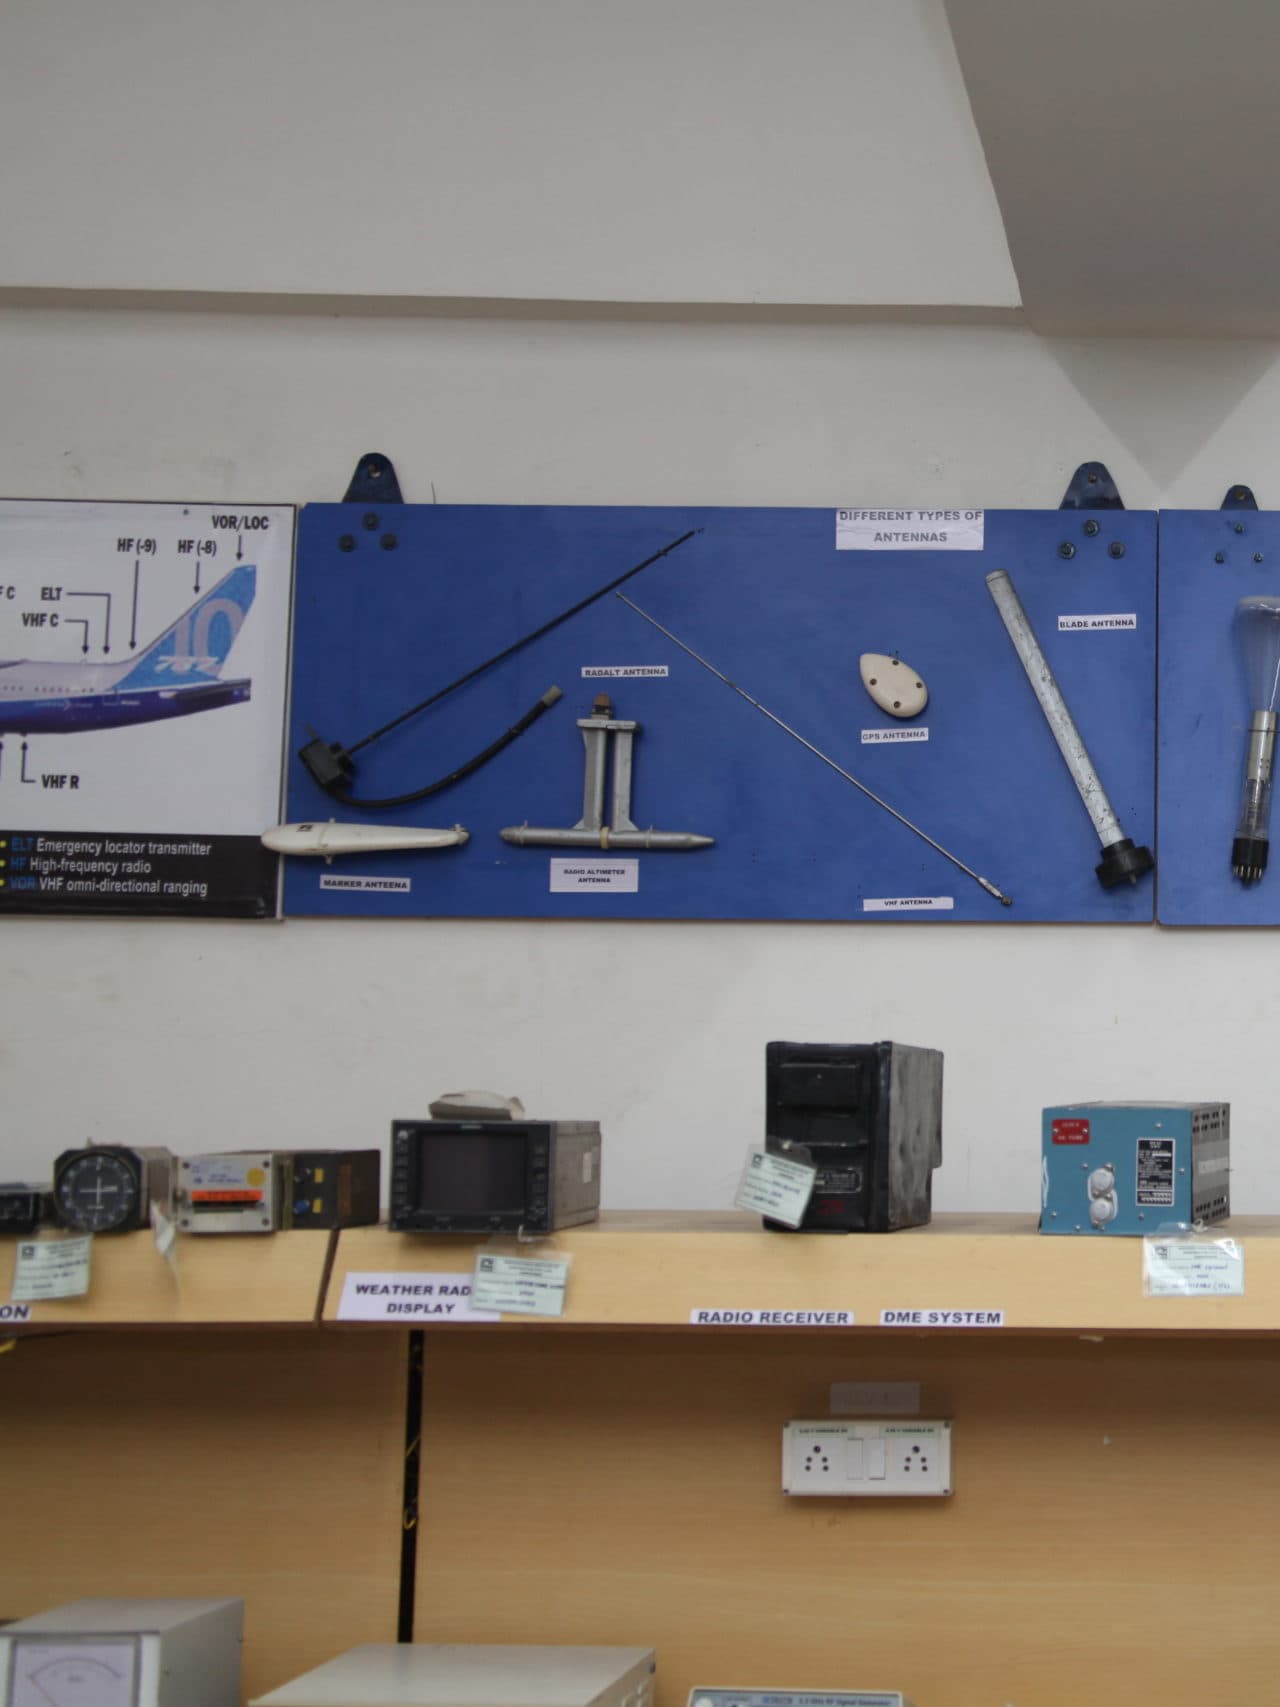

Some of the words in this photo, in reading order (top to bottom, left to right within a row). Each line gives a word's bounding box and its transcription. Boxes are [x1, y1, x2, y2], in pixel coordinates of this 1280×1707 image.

[839, 511, 913, 521] DIFFERENT
[918, 511, 961, 521] TYPES
[964, 511, 982, 521] OF
[212, 515, 269, 531] VOR/LOC
[874, 532, 948, 542] ANTENNAS
[117, 538, 134, 553] HF
[136, 538, 156, 555] (-9)
[178, 539, 195, 554] HF
[197, 540, 217, 557] (-8)
[41, 586, 63, 601] ELT
[22, 613, 49, 627] VHF
[50, 614, 59, 627] C
[1059, 620, 1089, 629] BLADE
[1091, 619, 1134, 627] ANTENNA
[623, 668, 667, 676] ANTENNA
[862, 733, 881, 741] GPS
[883, 731, 926, 739] ANTENNA
[41, 774, 68, 789] VHF
[70, 775, 79, 789] R
[37, 837, 102, 856] Emergency
[105, 840, 146, 854] locator
[148, 841, 212, 855] transmitter
[30, 857, 118, 876] High-frequency
[121, 859, 151, 874] radio
[40, 877, 64, 891] VHF
[66, 879, 160, 894] omni-directional
[163, 881, 208, 897] ranging
[323, 880, 362, 888] MARKER
[355, 1284, 433, 1297] WEATHER
[439, 1285, 472, 1297] RAD
[387, 1303, 455, 1314] DISPLAY
[698, 1311, 753, 1324] RADIO
[759, 1311, 848, 1324] RECEIVER
[884, 1311, 921, 1324] DME
[928, 1311, 1001, 1324] SYSTEM
